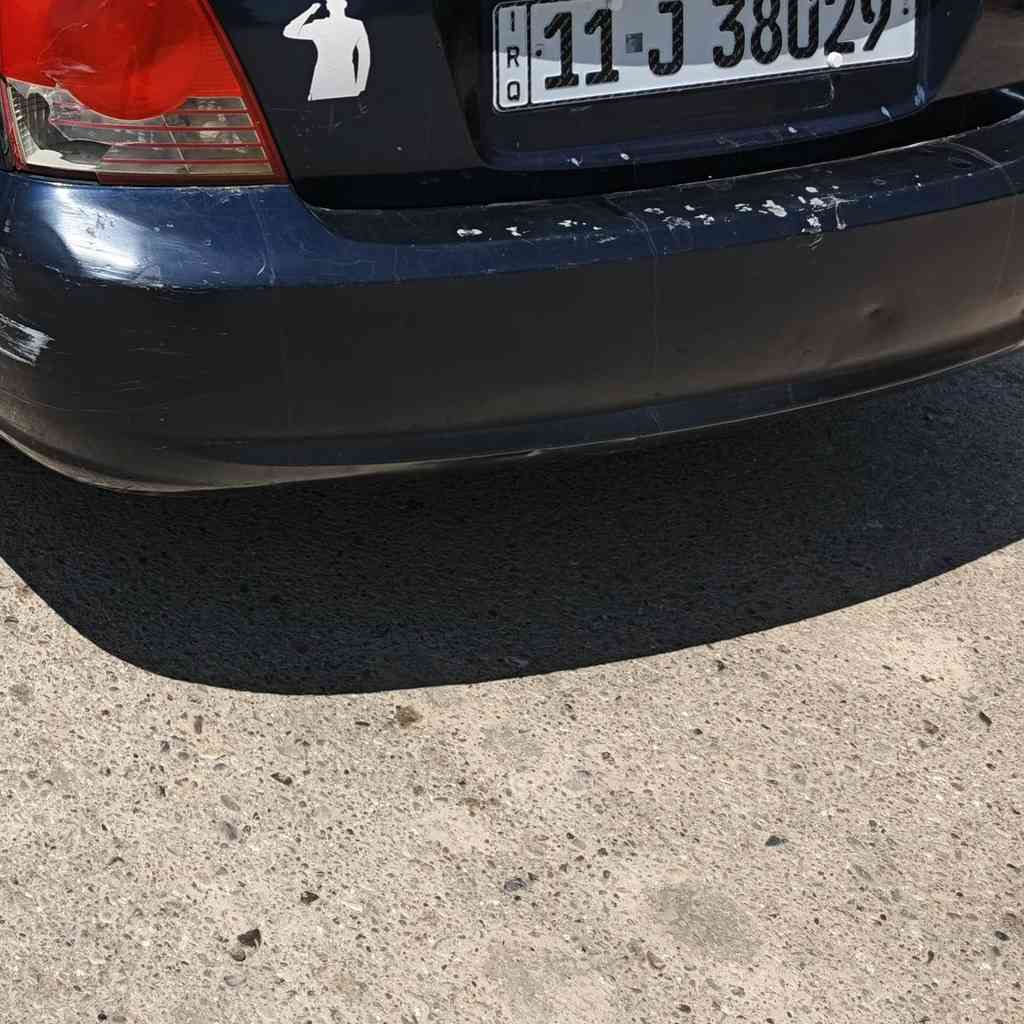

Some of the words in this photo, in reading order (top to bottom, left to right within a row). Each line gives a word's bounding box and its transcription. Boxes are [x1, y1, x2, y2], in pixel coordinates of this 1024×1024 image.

[506, 10, 521, 102] IRQ
[543, 8, 620, 90] 11
[647, 0, 685, 76] J
